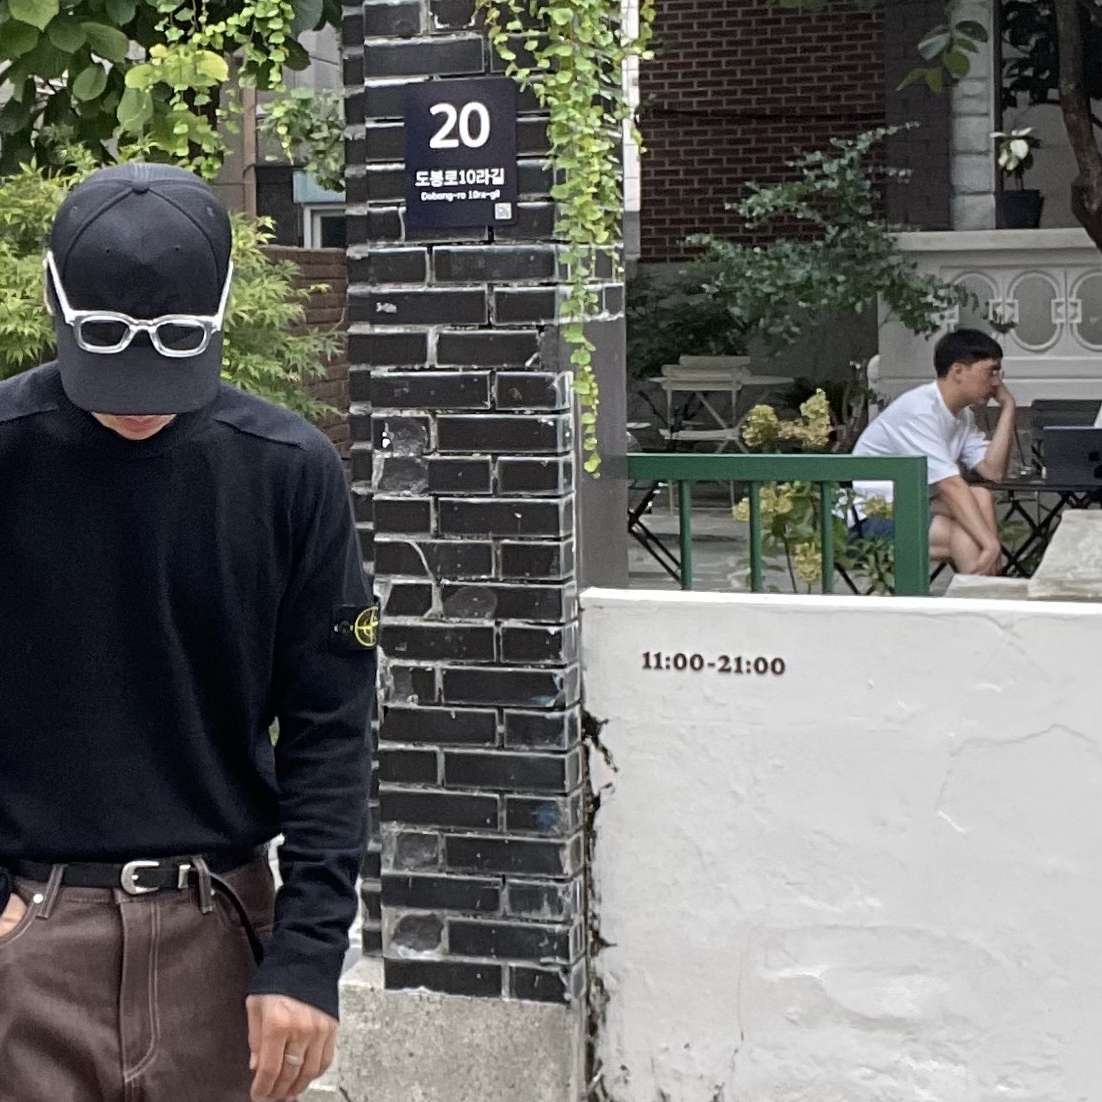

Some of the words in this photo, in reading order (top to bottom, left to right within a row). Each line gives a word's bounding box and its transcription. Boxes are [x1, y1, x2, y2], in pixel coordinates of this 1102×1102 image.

[429, 101, 491, 149] 20
[414, 168, 505, 188] 도봉로10라길
[642, 651, 787, 676] 11:00-21:00
